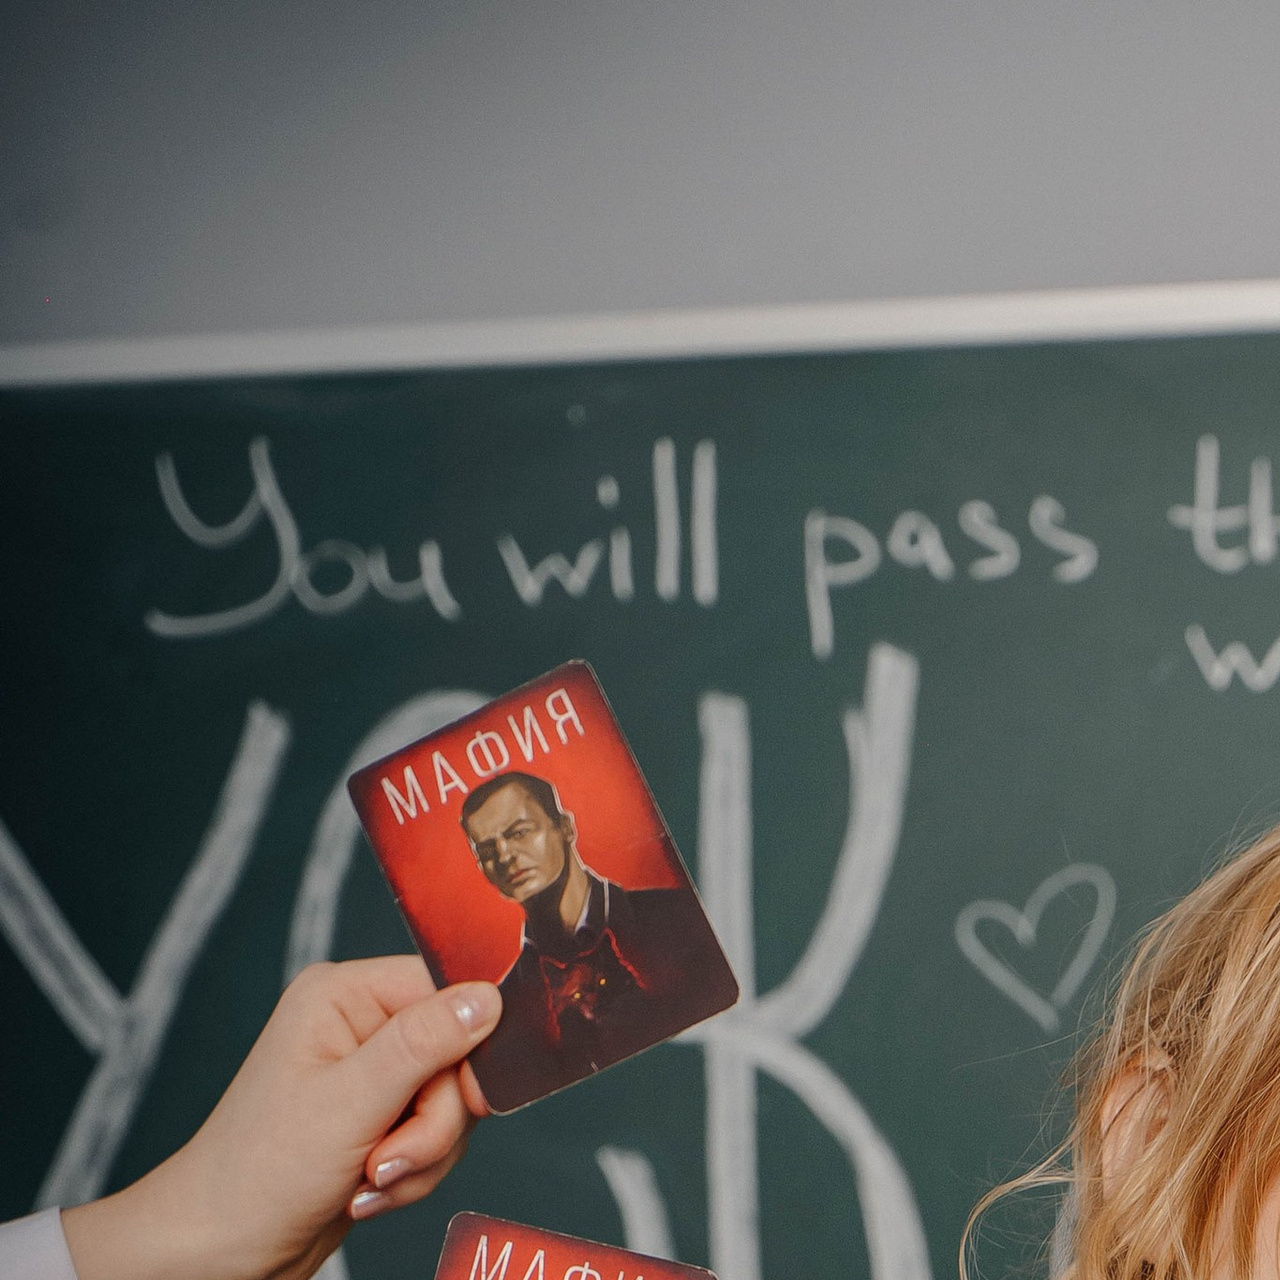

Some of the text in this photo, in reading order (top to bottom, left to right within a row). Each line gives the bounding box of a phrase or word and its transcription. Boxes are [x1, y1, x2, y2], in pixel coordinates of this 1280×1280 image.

[146, 437, 461, 637] You
[500, 438, 720, 606] will
[805, 495, 1100, 660] pass
[379, 686, 586, 826] МАФИЯ
